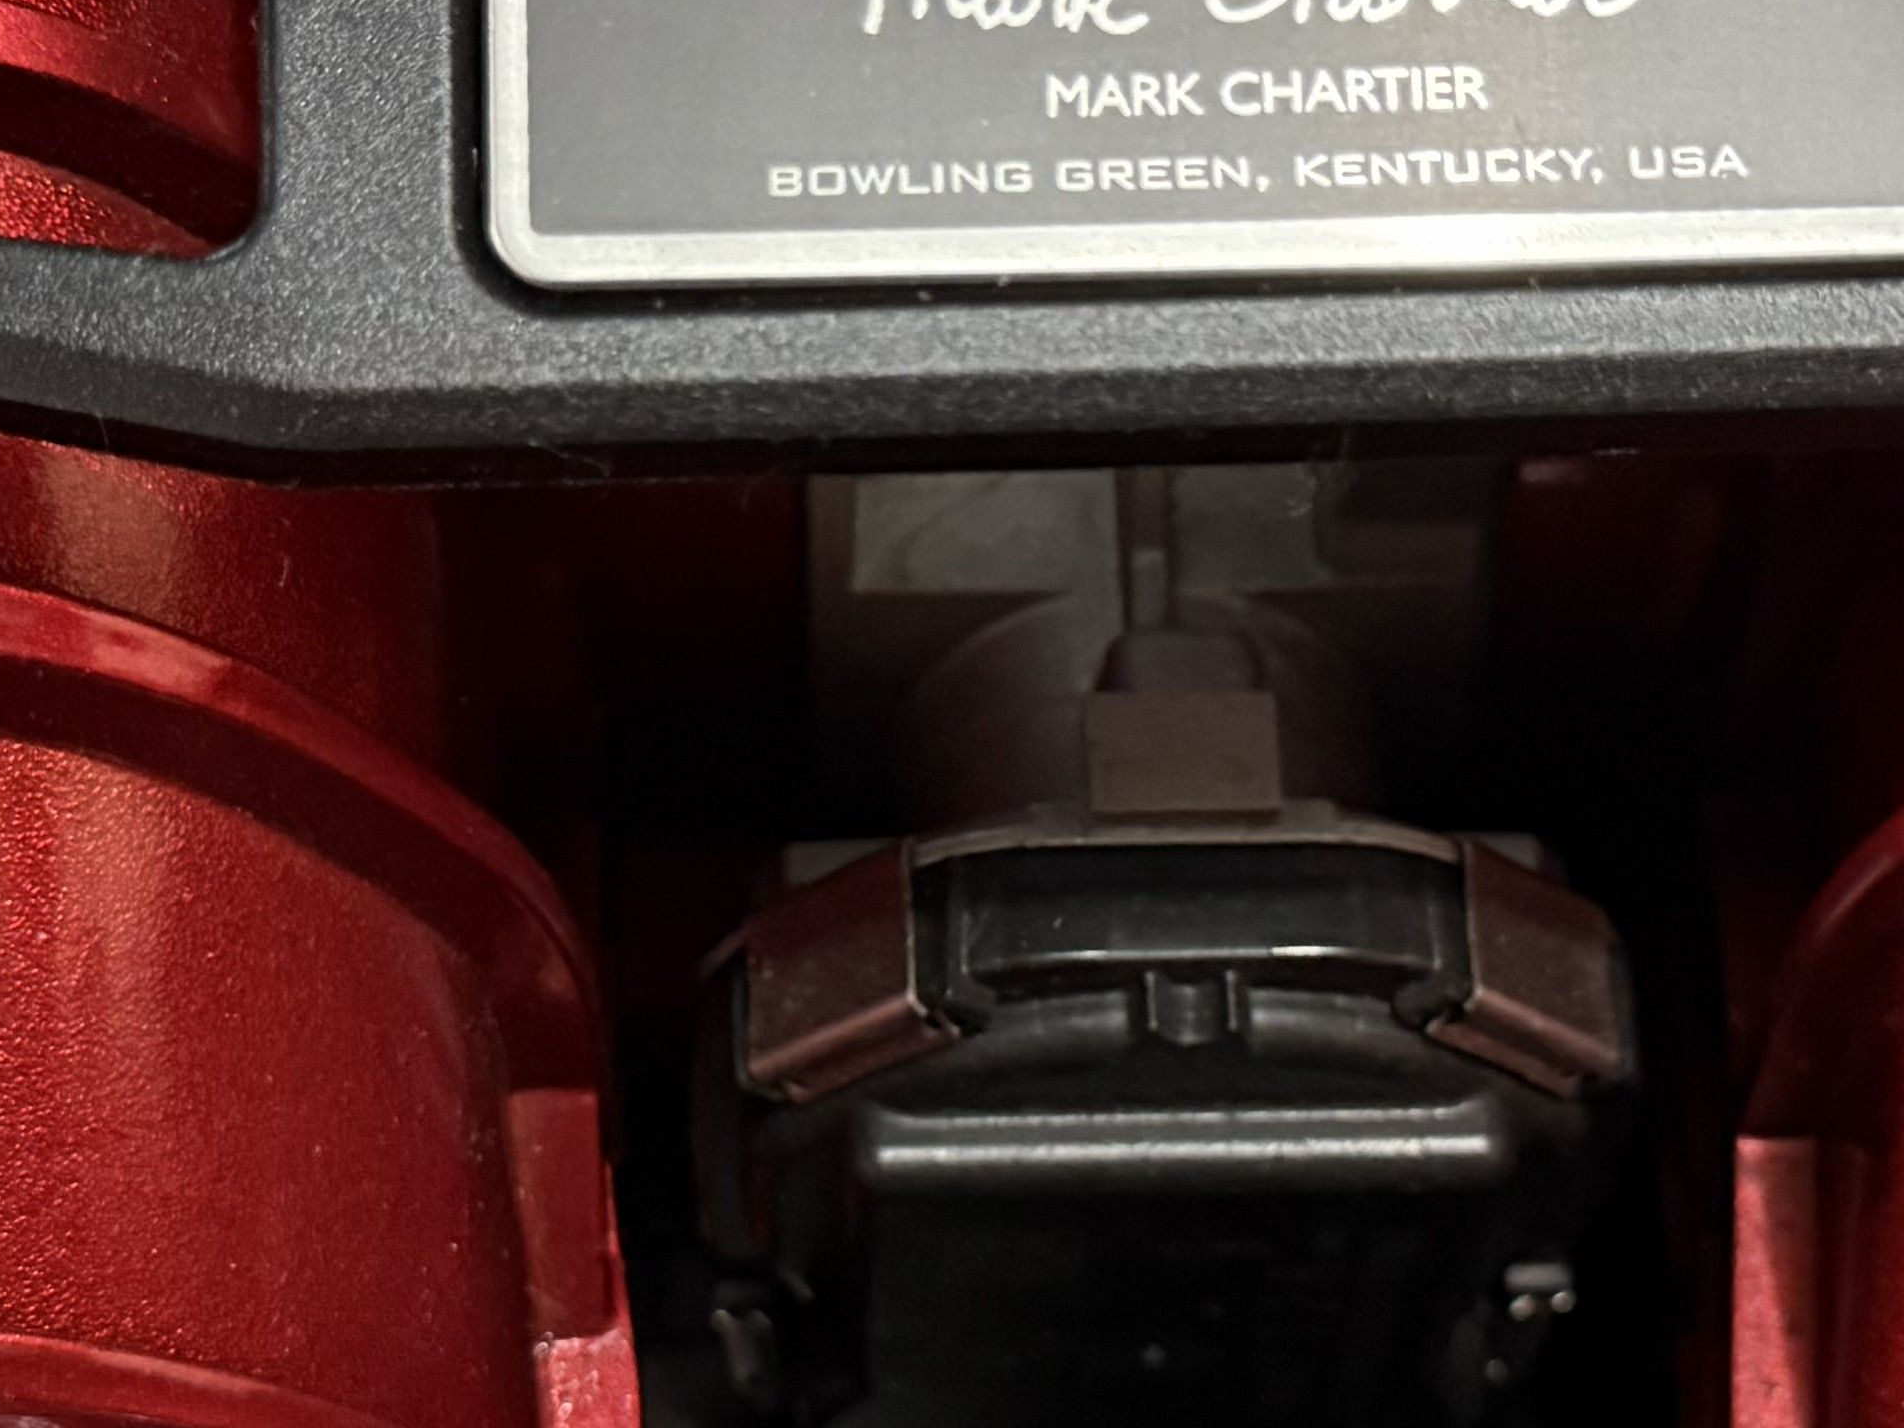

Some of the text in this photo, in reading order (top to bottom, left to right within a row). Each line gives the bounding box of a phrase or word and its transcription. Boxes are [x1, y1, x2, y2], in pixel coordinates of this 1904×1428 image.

[1045, 63, 1490, 120] MARK CHARTIER
[767, 143, 1750, 198] BOWLING GREEN, KENTUCKY, USA
